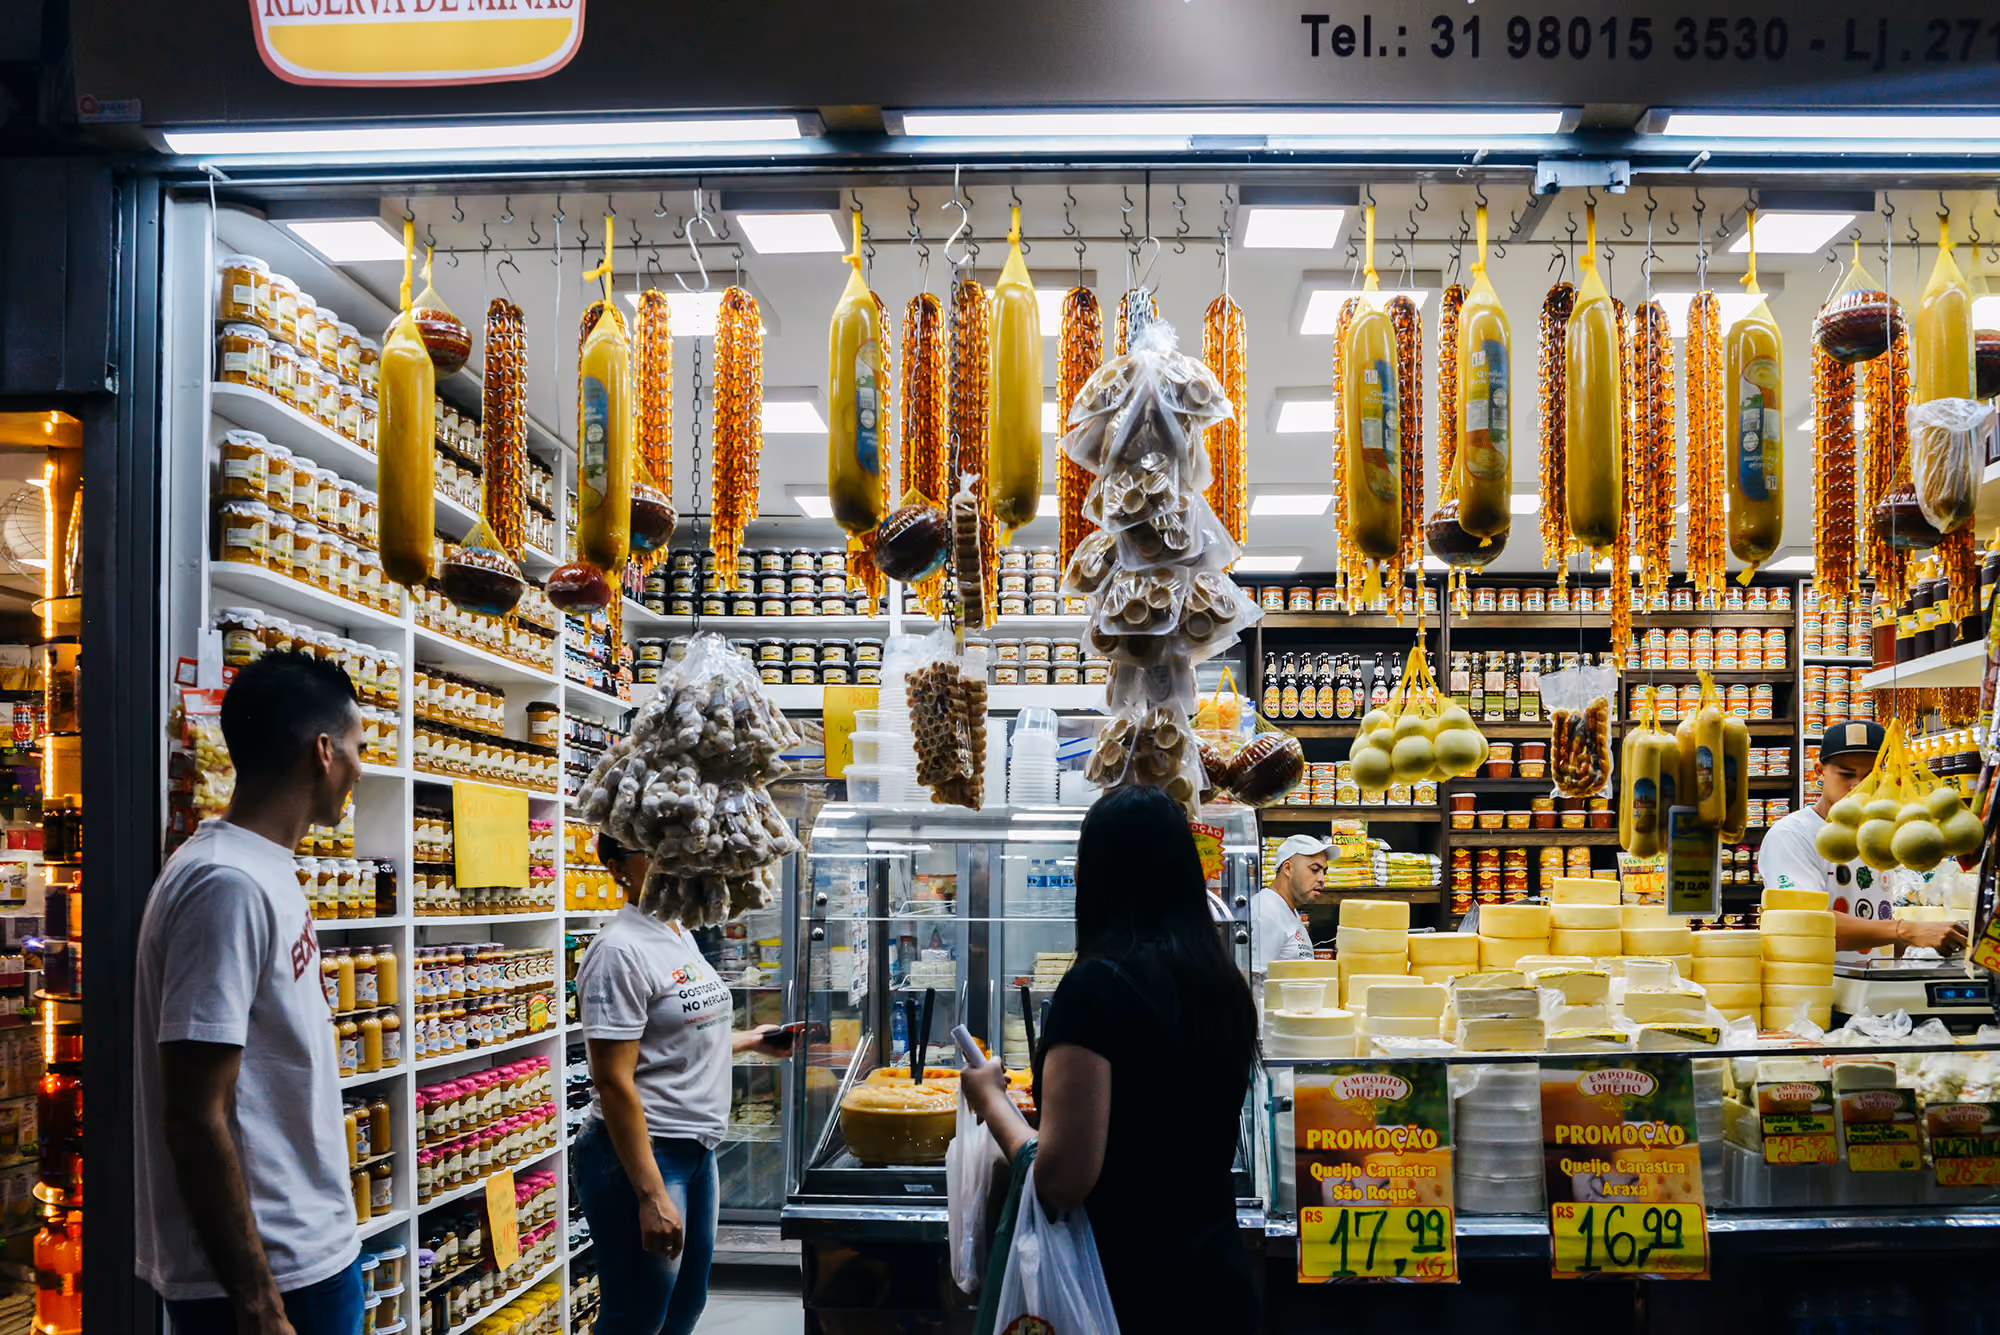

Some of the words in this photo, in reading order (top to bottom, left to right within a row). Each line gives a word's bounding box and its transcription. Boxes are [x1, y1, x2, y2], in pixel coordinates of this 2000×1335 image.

[1301, 14, 1406, 57] Tel.:
[1430, 15, 1480, 58] 31
[1506, 16, 1653, 60] 98015
[1672, 17, 1788, 60] 3530
[682, 1001, 700, 1013] NO
[1306, 1124, 1438, 1155] PROMOÇÃO
[1555, 1121, 1685, 1151] PROMOÇÃO
[1310, 1162, 1362, 1181] Queijo
[1366, 1162, 1437, 1178] Canastra
[1560, 1158, 1611, 1176] Queijo
[1615, 1159, 1685, 1174] Canastra
[1333, 1185, 1363, 1200] São
[1367, 1186, 1417, 1203] Roque
[1602, 1180, 1648, 1196] Araxá
[1304, 1210, 1323, 1223] R$
[1556, 1206, 1575, 1219] R$
